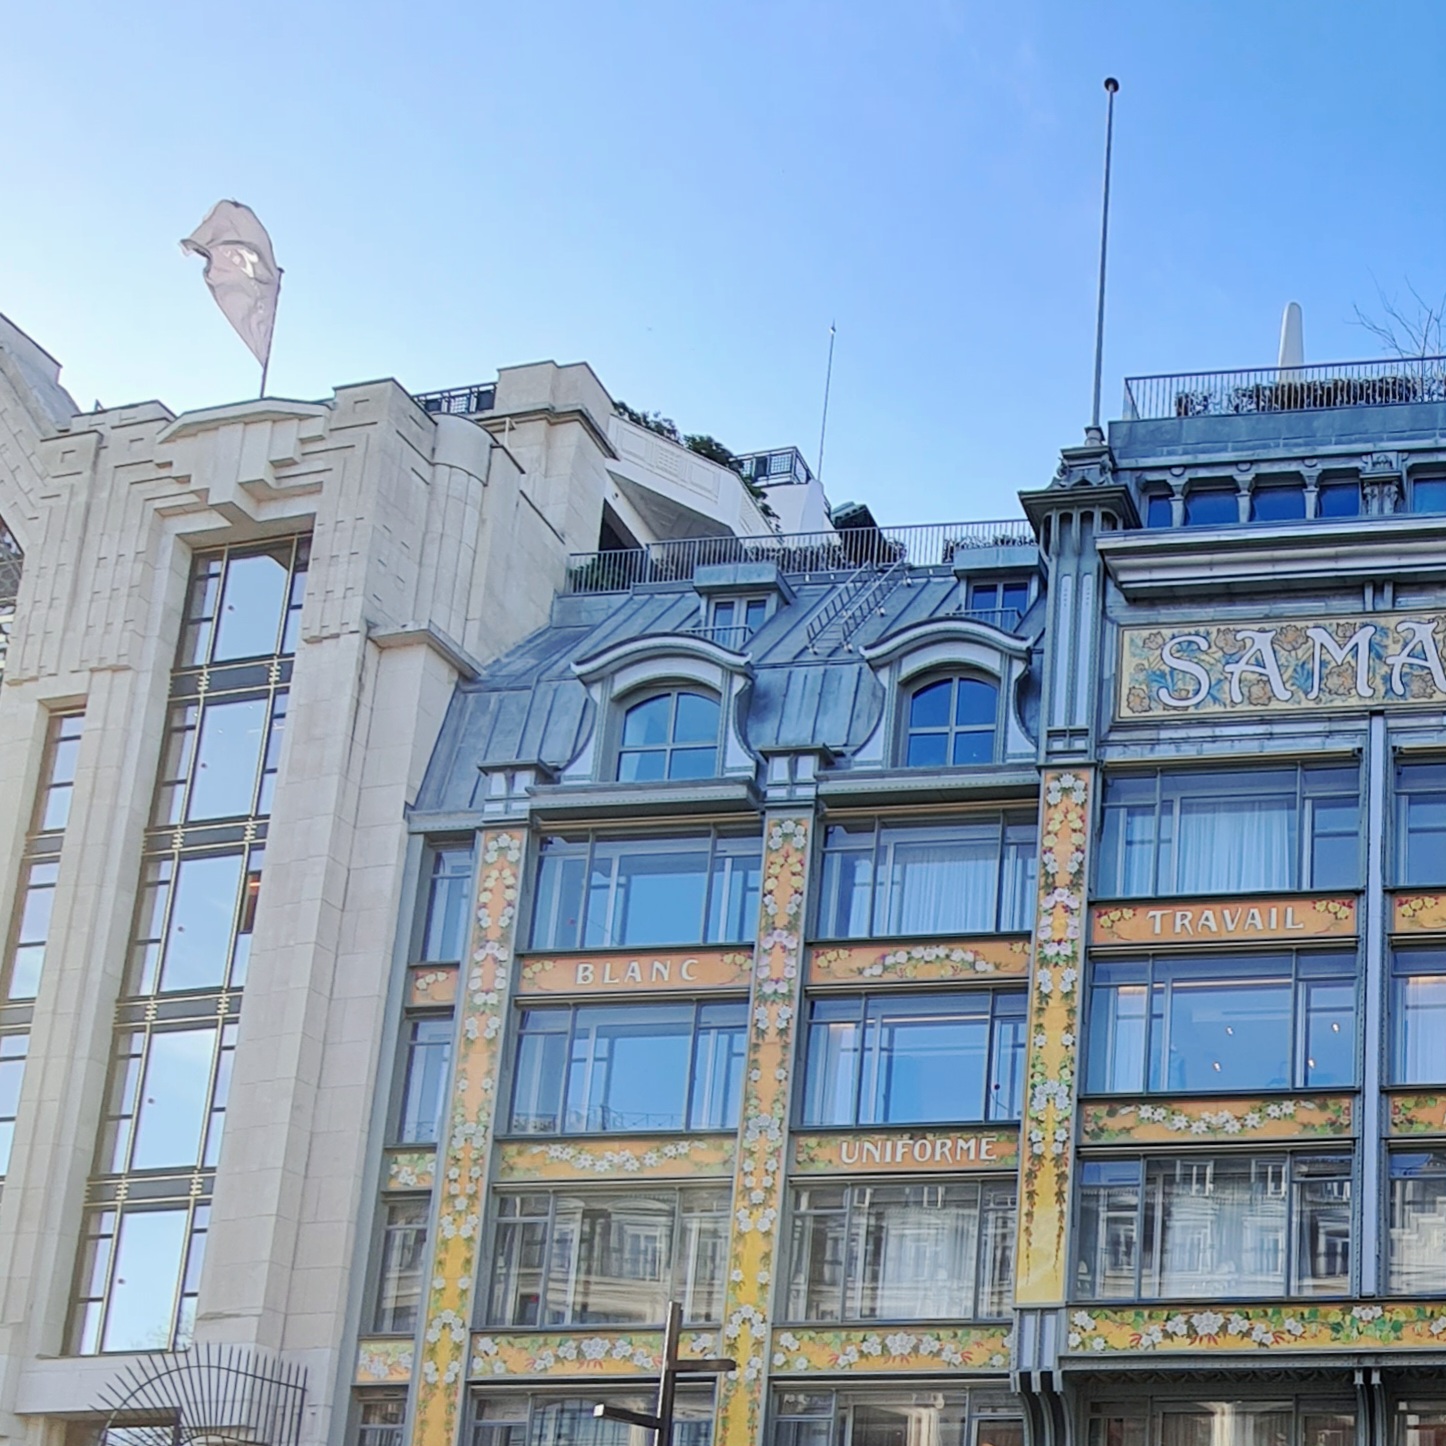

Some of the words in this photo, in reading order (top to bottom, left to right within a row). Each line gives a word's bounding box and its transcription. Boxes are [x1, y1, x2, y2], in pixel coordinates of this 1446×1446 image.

[1147, 907, 1303, 934] TRAVAIL
[575, 959, 699, 985] BLANC
[840, 1138, 998, 1163] UNIFORME
